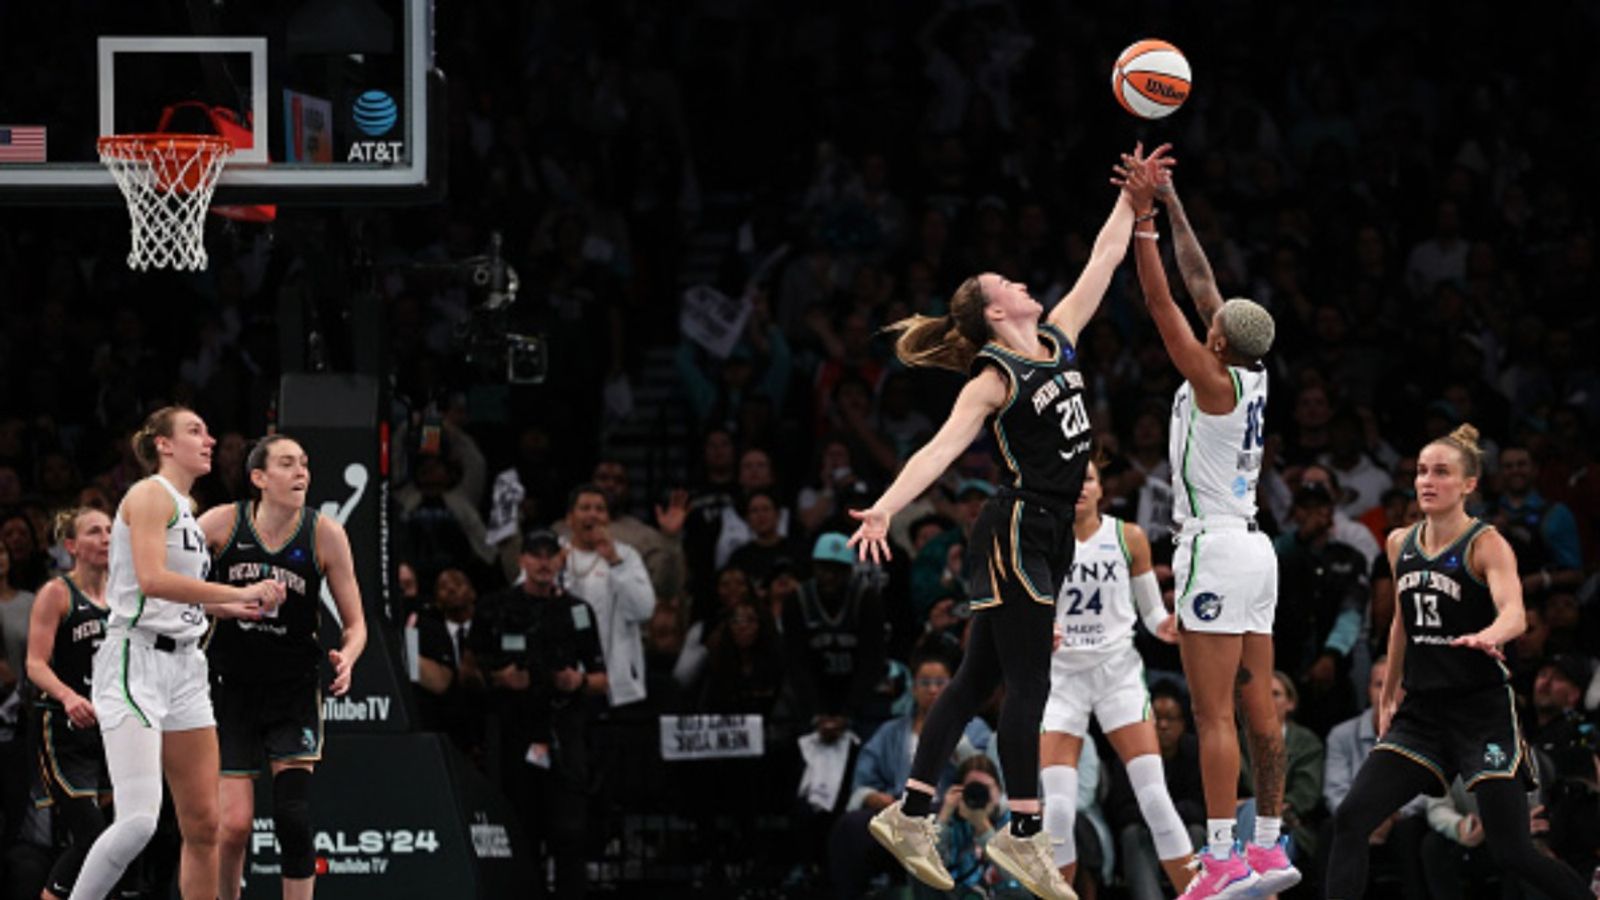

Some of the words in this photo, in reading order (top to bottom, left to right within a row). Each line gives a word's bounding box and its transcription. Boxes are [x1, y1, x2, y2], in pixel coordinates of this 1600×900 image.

[347, 142, 403, 163] AT&T
[1056, 392, 1091, 440] 20
[1066, 560, 1118, 583] YNX
[1065, 586, 1103, 616] 24
[1413, 592, 1442, 627] 13
[371, 857, 389, 874] TV
